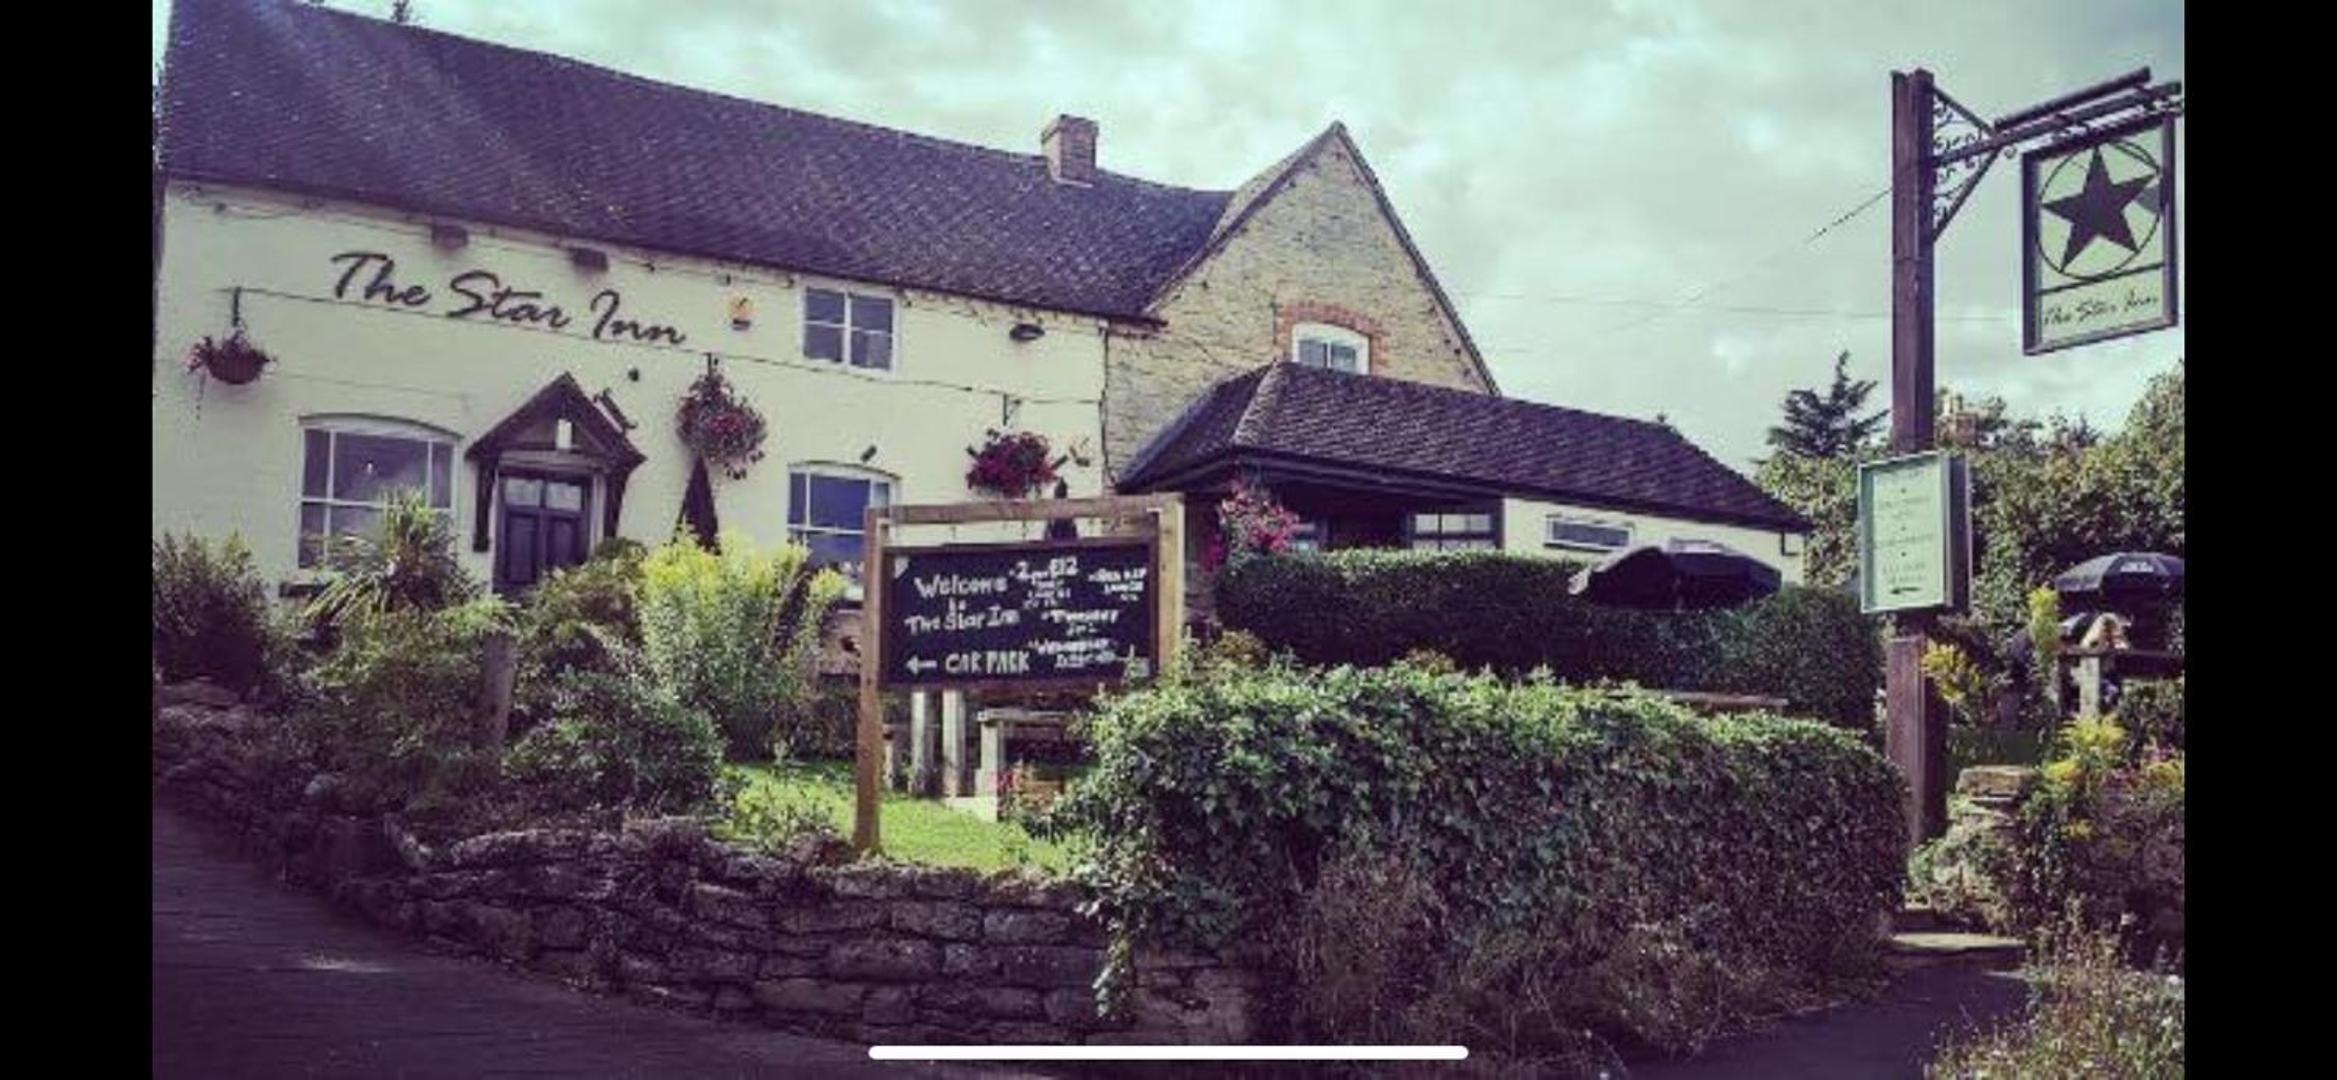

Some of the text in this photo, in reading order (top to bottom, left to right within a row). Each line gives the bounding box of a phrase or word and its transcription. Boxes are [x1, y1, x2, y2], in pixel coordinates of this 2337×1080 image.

[331, 252, 686, 346] The Star Inn
[2043, 289, 2159, 325] The Star Inn
[914, 574, 1008, 598] Welcome
[904, 614, 941, 634] The
[943, 611, 986, 631] Star
[986, 602, 1021, 627] Inn
[945, 651, 982, 674] CAR
[985, 650, 1030, 675] PARK
